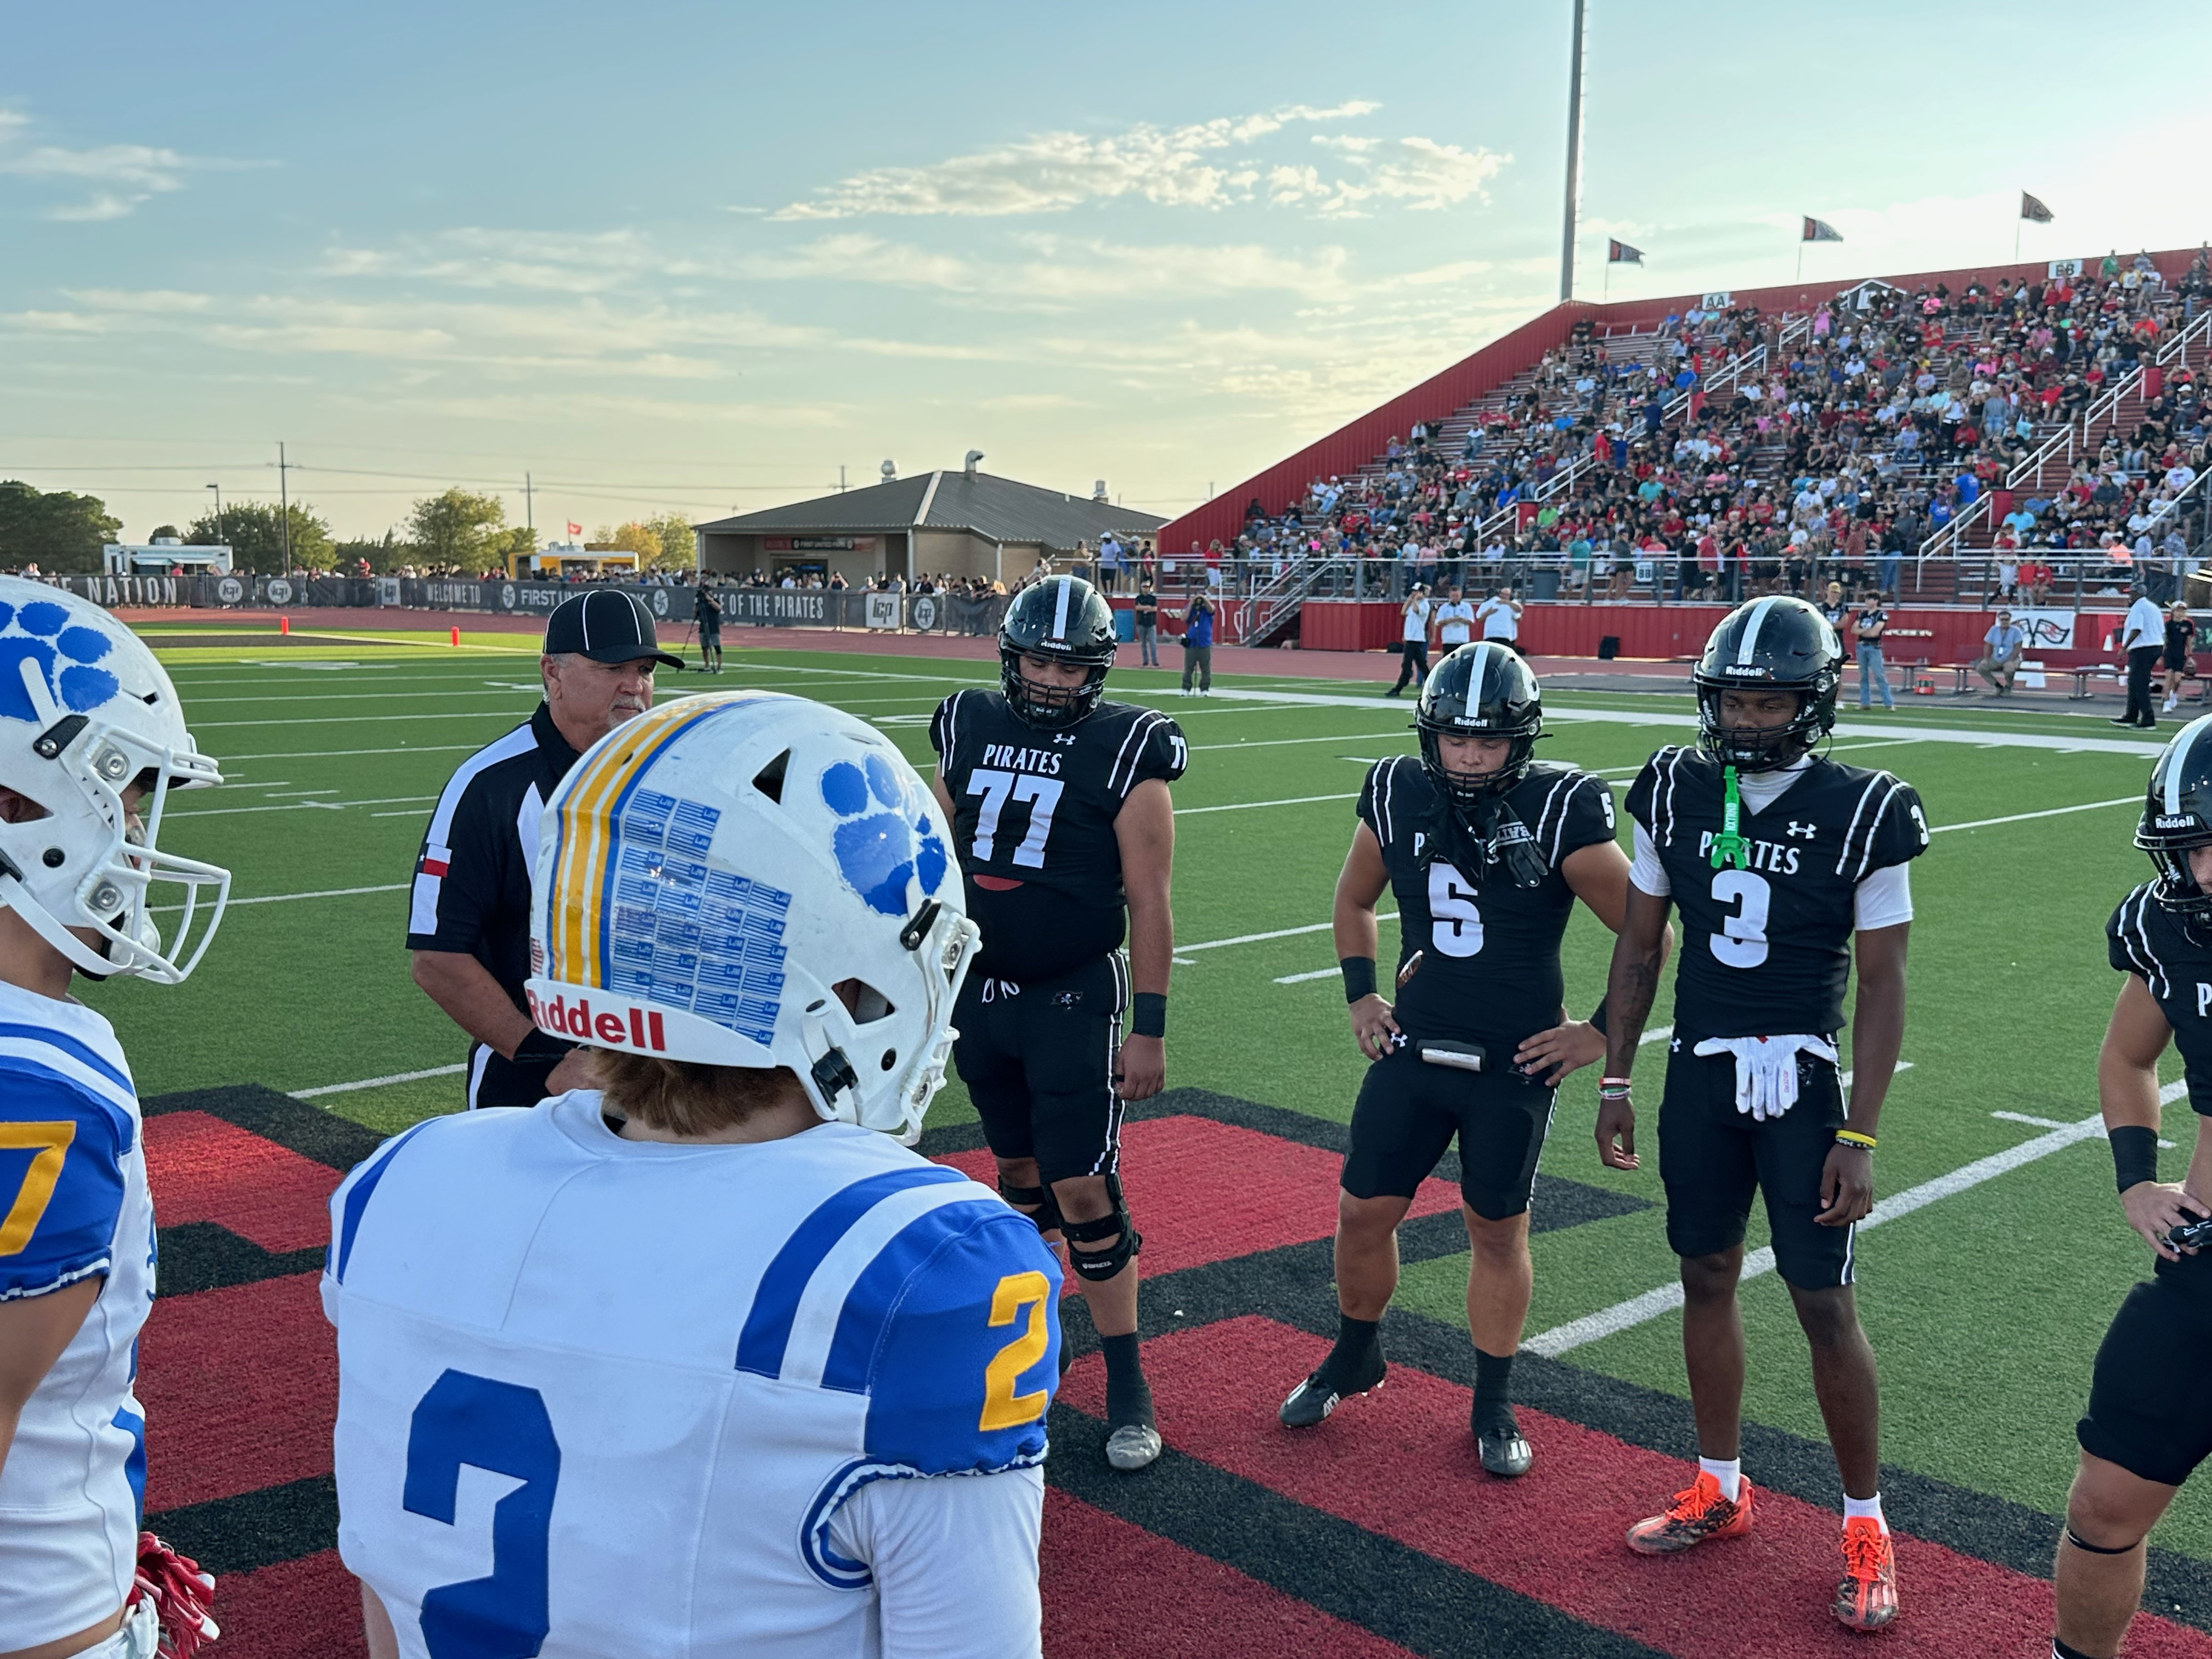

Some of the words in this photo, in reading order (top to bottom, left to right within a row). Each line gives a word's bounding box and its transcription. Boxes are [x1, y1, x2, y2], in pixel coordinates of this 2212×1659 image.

[1706, 296, 1725, 308] AA
[87, 577, 177, 604] NATION
[427, 584, 467, 603] WELCOME
[470, 585, 481, 603] TO
[522, 589, 555, 606] FIRST
[729, 594, 743, 615] OF
[749, 595, 770, 617] THE
[774, 595, 823, 619] PIRATES
[1725, 666, 1764, 676] Riddell
[1454, 716, 1488, 727] Riddell
[983, 744, 1062, 775] PIRATES
[1169, 735, 1187, 771] 77
[966, 769, 1065, 869] 77
[1600, 792, 1615, 829] 5
[1910, 805, 1930, 845] 3
[2155, 815, 2194, 829] Riddell
[1427, 862, 1484, 958] 5
[1709, 869, 1771, 968] 3
[527, 989, 666, 1052] Riddell
[0, 1120, 76, 1256] 7
[979, 1271, 1051, 1432] 2
[403, 1367, 562, 1659] 2
